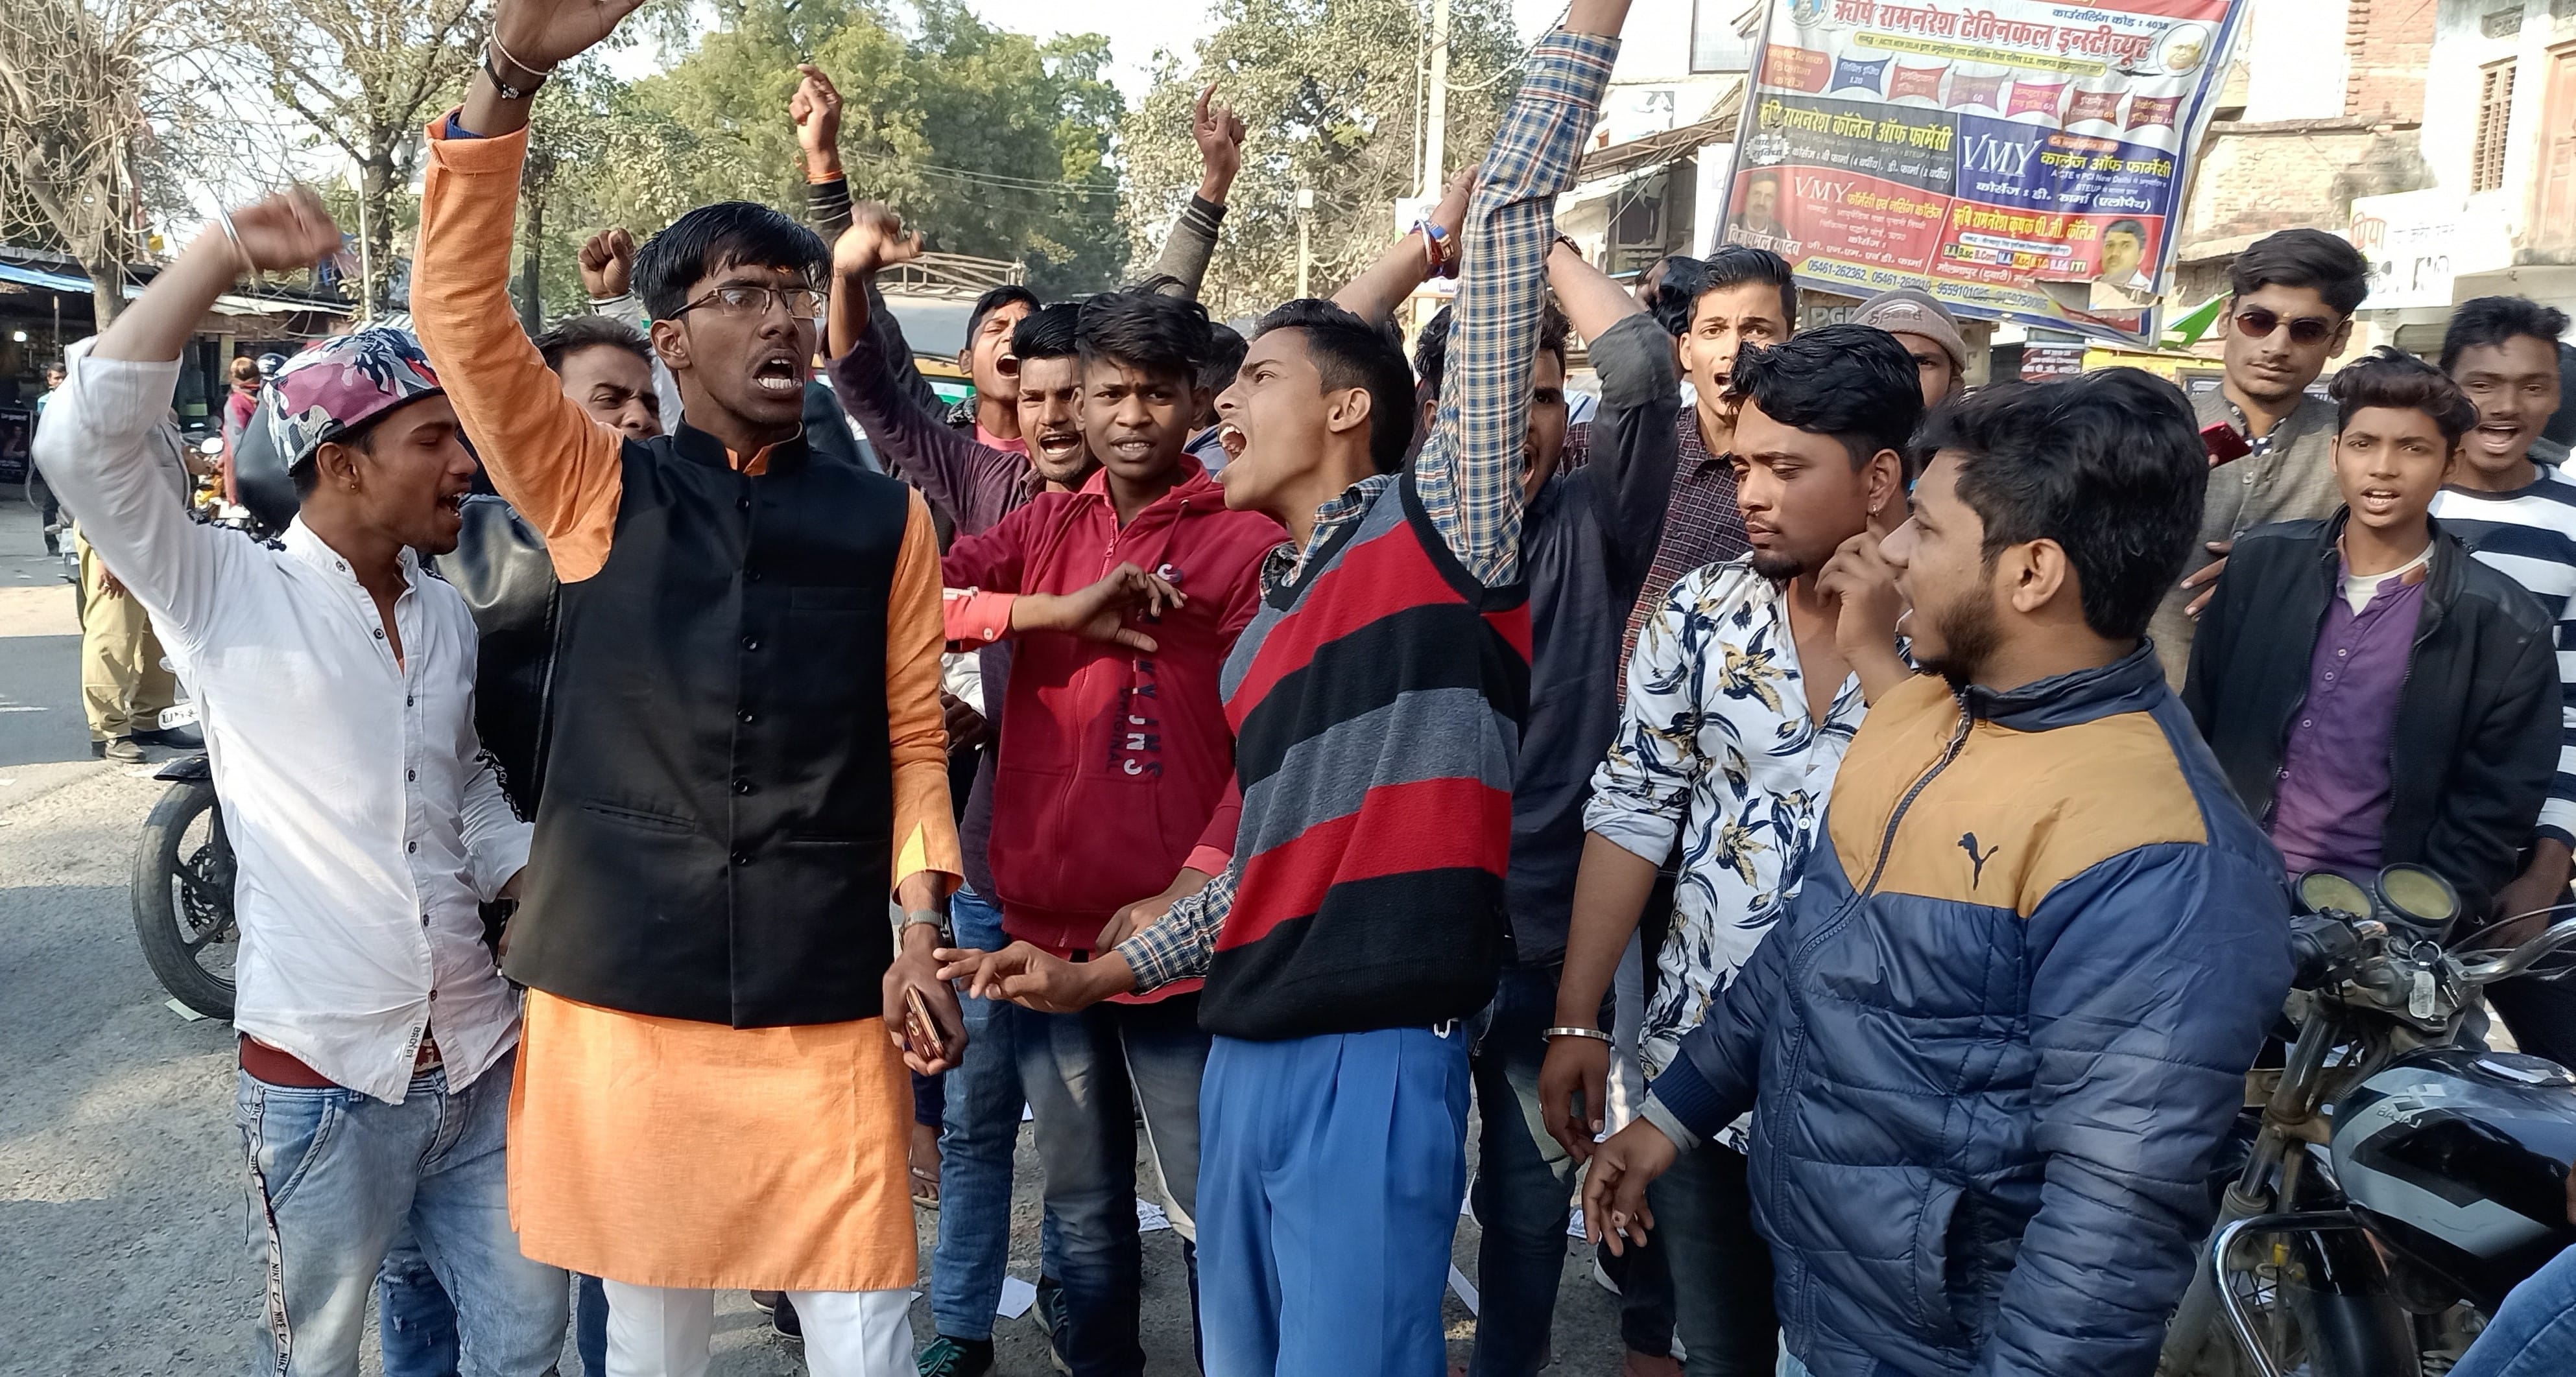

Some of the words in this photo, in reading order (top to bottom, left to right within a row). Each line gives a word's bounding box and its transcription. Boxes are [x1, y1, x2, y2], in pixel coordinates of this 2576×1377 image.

[1879, 3, 1959, 36] रामनरेश
[1783, 106, 1832, 134] रामनरेश
[1833, 111, 1876, 141] कॉलेज
[1876, 117, 1909, 145] ऑफ
[1962, 133, 2044, 178] VMY
[2089, 155, 2124, 172] ऑफ
[1794, 176, 1855, 204] VMY
[2377, 1105, 2422, 1129] BAJAJ
[272, 1310, 287, 1329] NIKE
